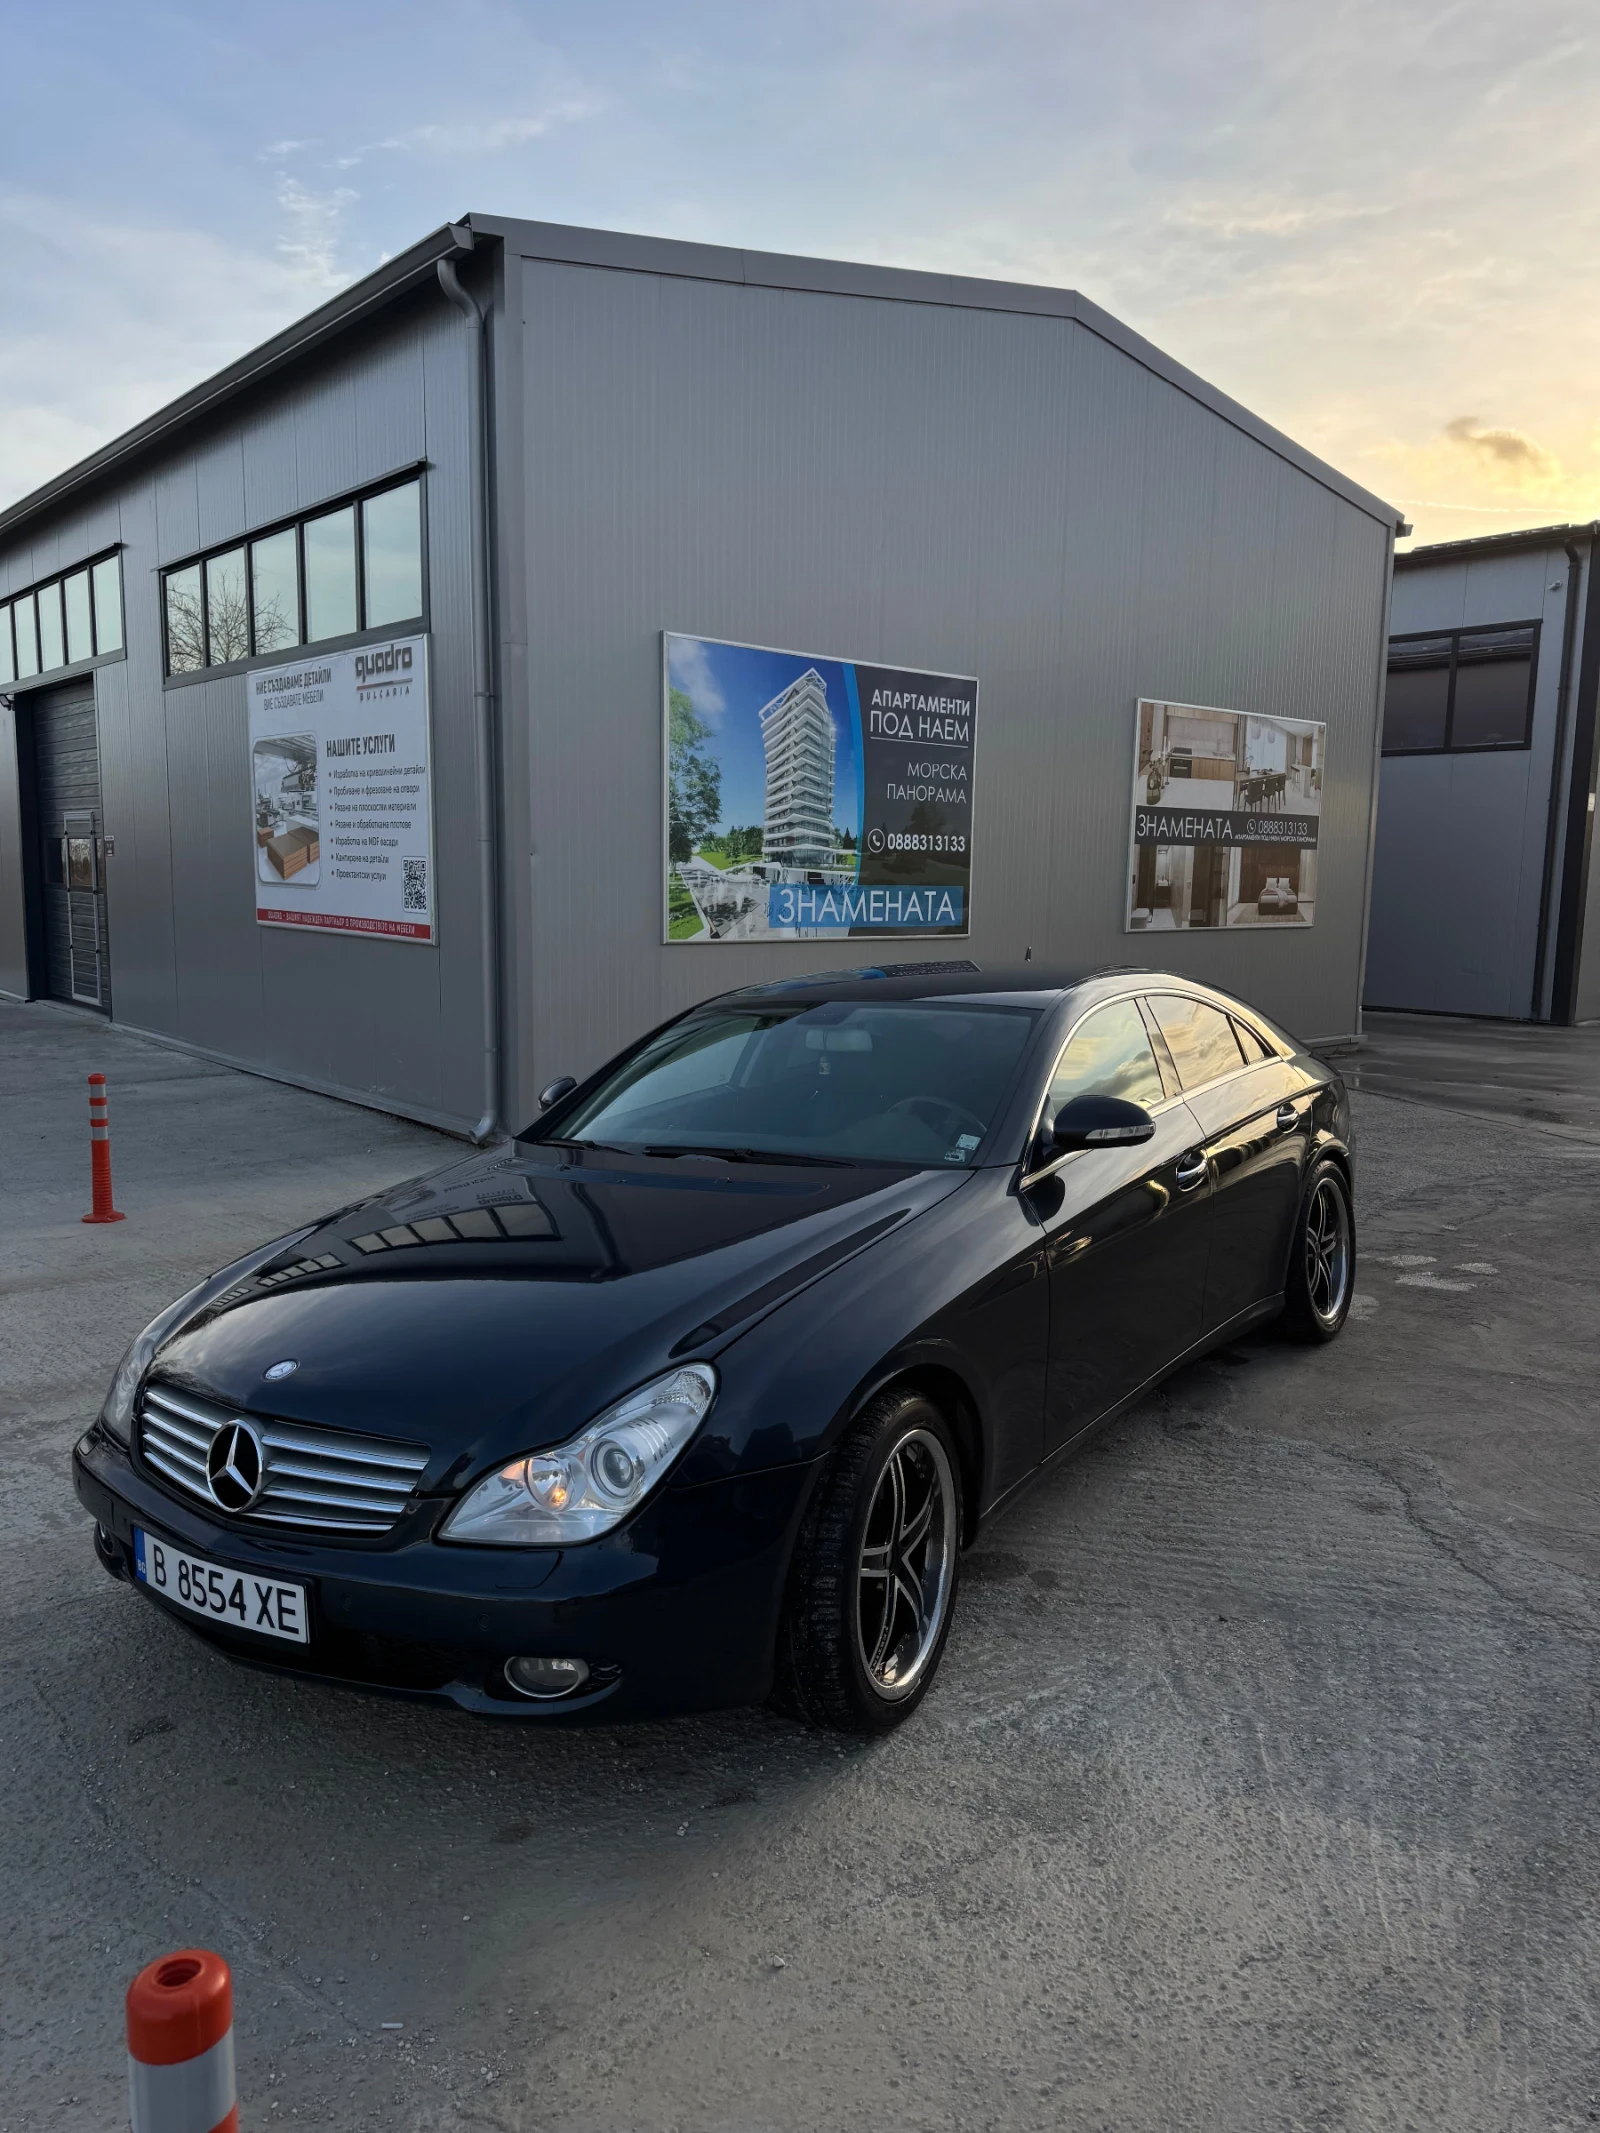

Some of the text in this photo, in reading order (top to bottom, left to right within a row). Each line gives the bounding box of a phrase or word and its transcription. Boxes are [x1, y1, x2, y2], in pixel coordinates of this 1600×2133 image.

[356, 644, 412, 682] quadro
[256, 667, 332, 695] НИЕ СЪЗДАВАМЕ ДЕТАЙЛИ
[274, 693, 302, 709] СЪЗДАВАТЕ
[303, 689, 324, 704] МЕБЕЛИ
[871, 689, 970, 716] АПАРТАМЕНТИ
[870, 710, 969, 742] ПОД НАЕМ
[326, 734, 396, 757] НАШИТЕ УСЛУГИ
[333, 769, 358, 780] Изработка
[404, 765, 425, 776] детайли
[907, 762, 967, 781] МОРСКА
[334, 786, 360, 798] Пробиване
[365, 785, 393, 796] фрезоване
[887, 783, 967, 804] ПАНОРАМА
[352, 804, 358, 812] на
[1136, 814, 1233, 840] ЗНАМЕНАТА
[1258, 820, 1308, 836] 0888313133
[887, 833, 966, 853] 0888313133
[778, 889, 956, 923] ЗНАМЕНАТА
[137, 1560, 147, 1575] BG
[178, 1559, 246, 1621] 8554
